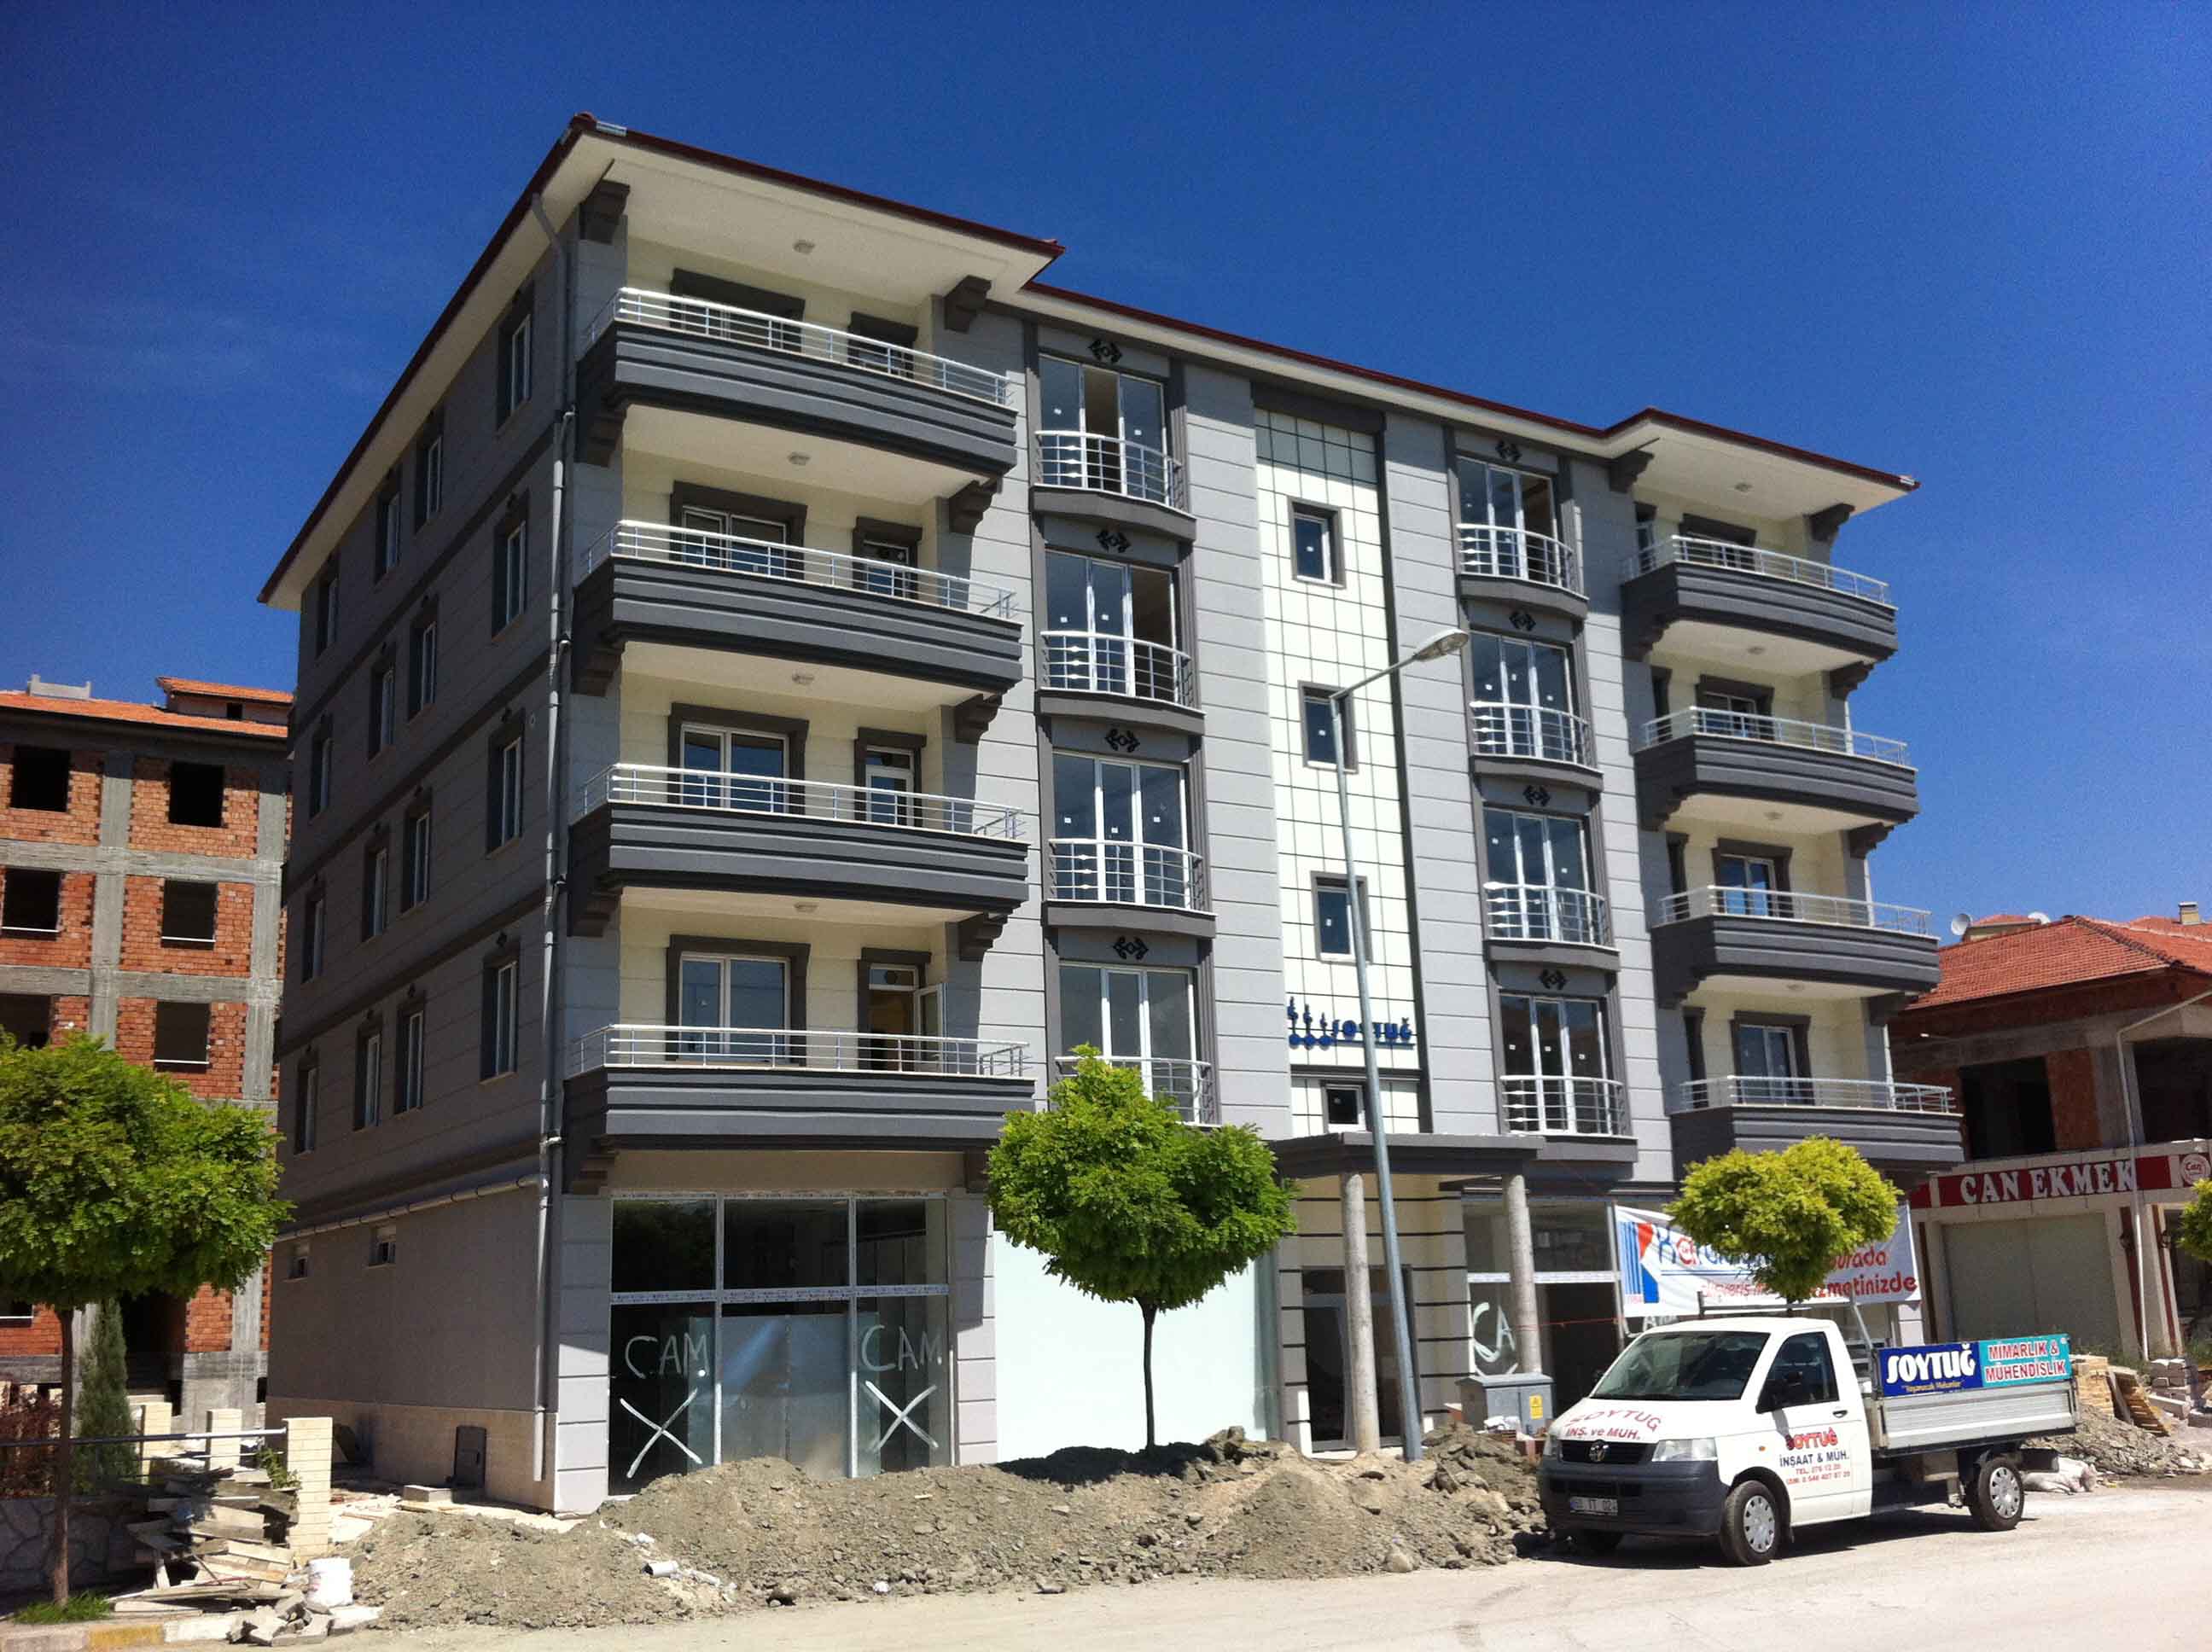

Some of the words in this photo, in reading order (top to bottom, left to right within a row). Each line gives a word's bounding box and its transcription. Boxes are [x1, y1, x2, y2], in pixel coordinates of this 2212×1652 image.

[1331, 1017, 1412, 1040] SOTUĞ
[1959, 1171, 2021, 1204] CAN
[2029, 1160, 2133, 1199] EKMEK
[861, 1324, 942, 1372] CAM
[1473, 1301, 1516, 1363] CA
[2050, 1339, 2060, 1356] &
[625, 1332, 710, 1379] CAM
[1887, 1343, 1976, 1383] SOYTUĞ
[1984, 1357, 2067, 1383] MÜHENDİSLİK
[1590, 1428, 1604, 1436] ve
[1779, 1453, 1813, 1469] İNŞAAT
[1816, 1452, 1824, 1463] &
